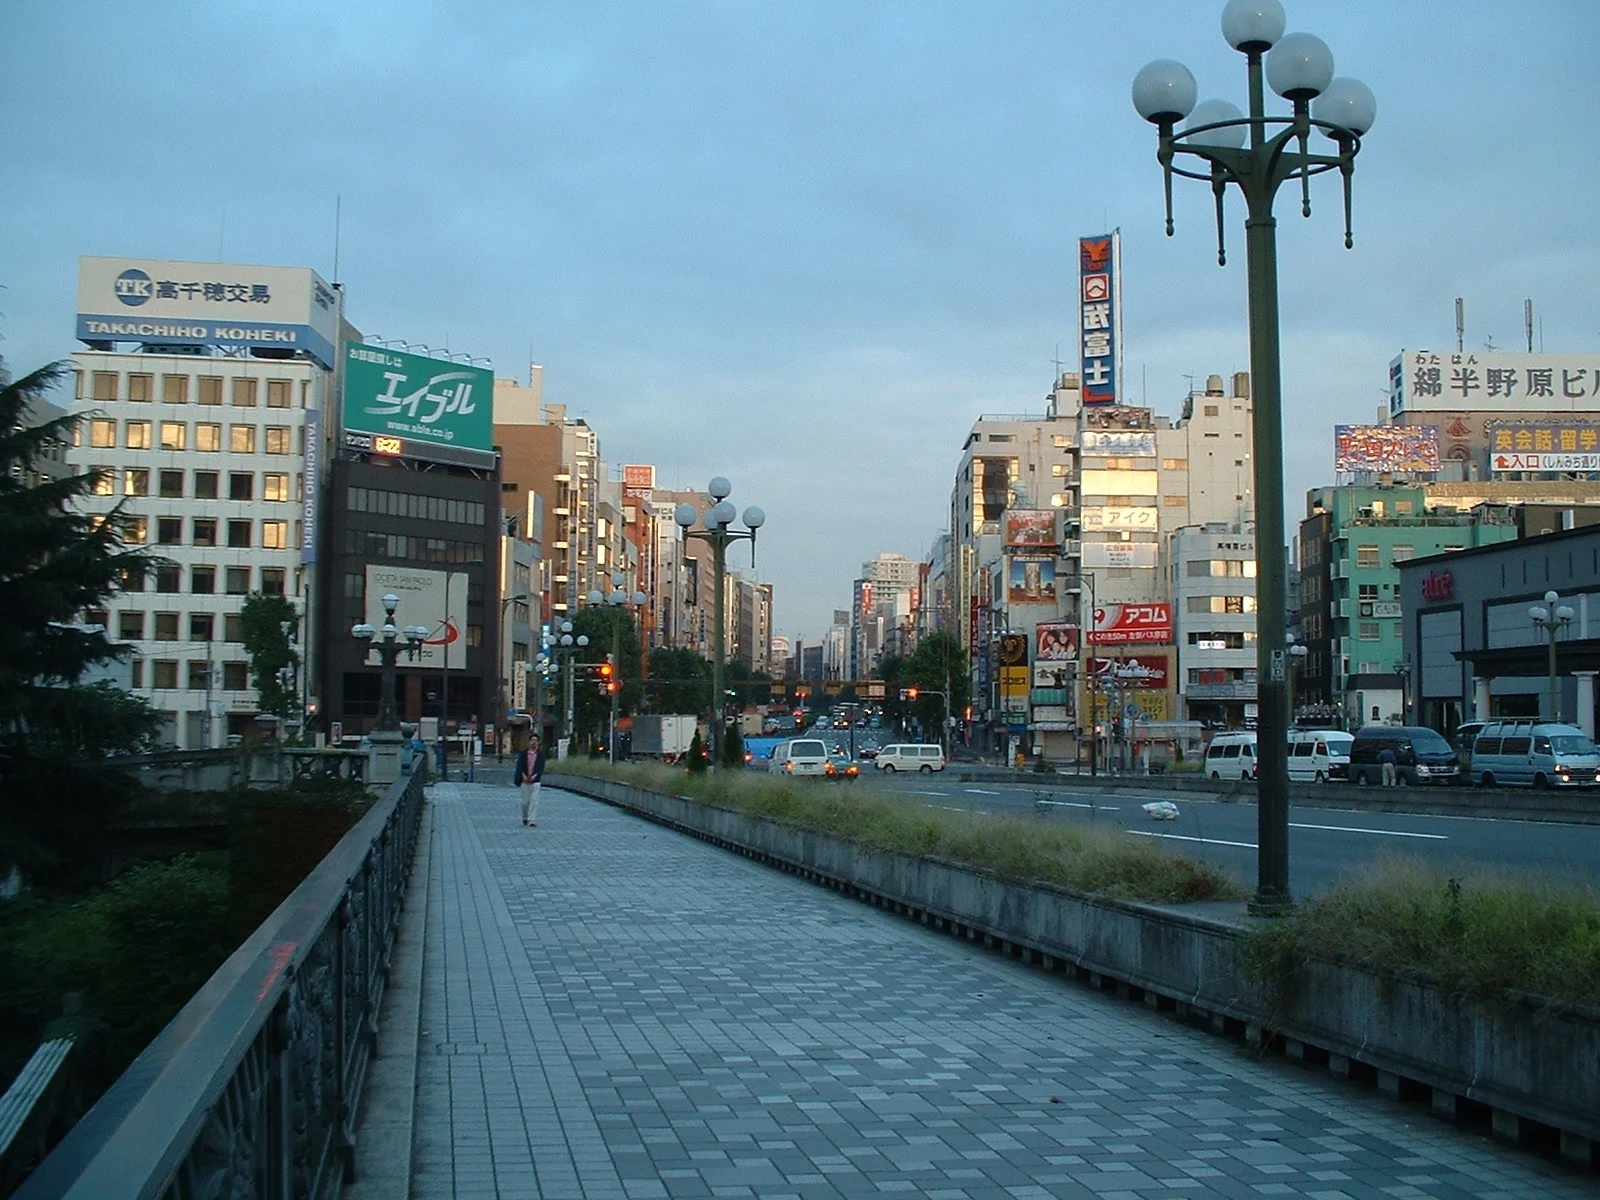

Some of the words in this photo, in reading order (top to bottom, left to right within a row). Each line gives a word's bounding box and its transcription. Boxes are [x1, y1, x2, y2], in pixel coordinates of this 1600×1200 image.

[116, 279, 149, 296] TK
[156, 280, 271, 304] 高千穂交易
[86, 321, 207, 339] TAKACHIHO
[215, 326, 296, 342] KOHEKI
[1083, 303, 1110, 385] 武富士
[376, 371, 475, 423] エイブル
[1511, 454, 1539, 468] 入口
[1542, 455, 1600, 469] (しんみち通り
[1108, 511, 1150, 524] アイク
[1125, 607, 1168, 624] アコム
